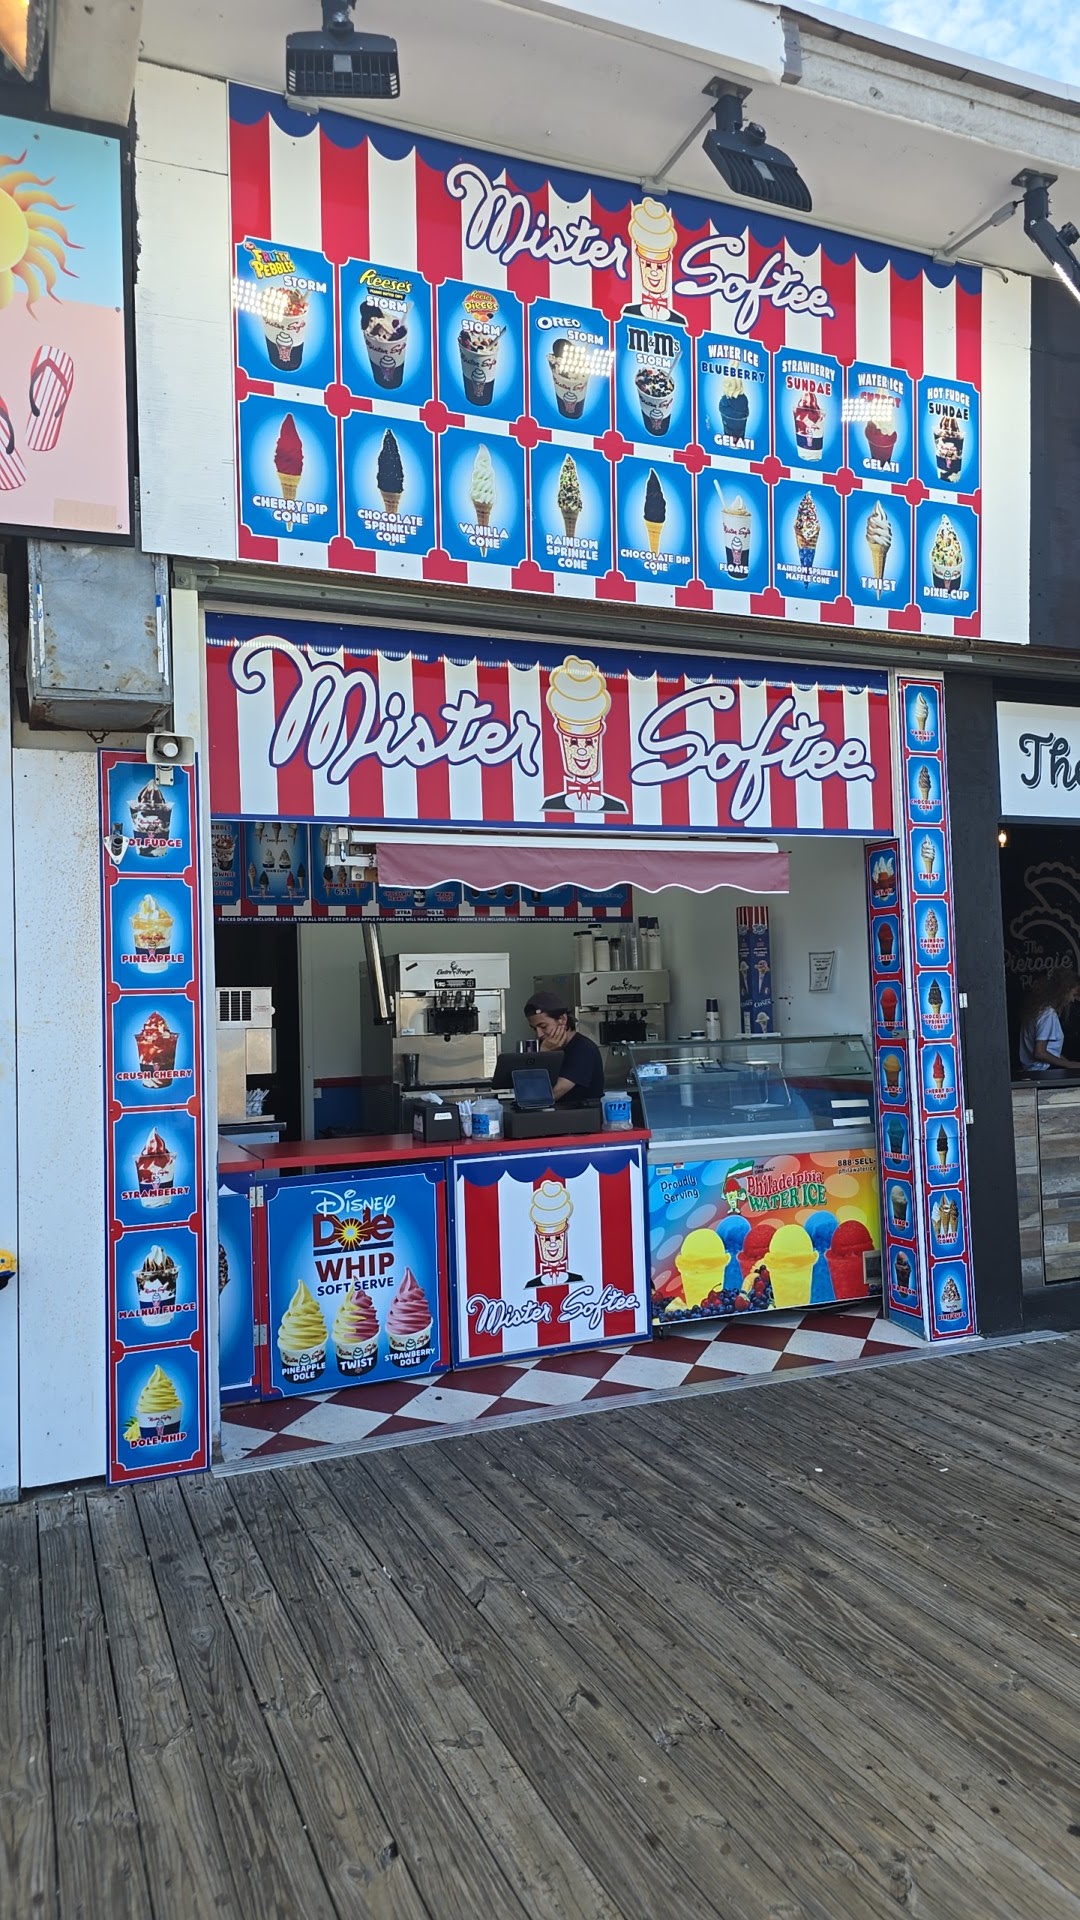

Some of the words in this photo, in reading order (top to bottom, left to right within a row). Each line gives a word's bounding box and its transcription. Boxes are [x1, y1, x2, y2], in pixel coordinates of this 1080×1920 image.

[253, 249, 291, 262] FRUITY
[446, 162, 628, 279] Mister
[674, 235, 834, 334] Softee
[251, 259, 295, 279] PEBBLES
[283, 276, 326, 293] STORM
[360, 268, 413, 294] Reese's
[366, 295, 407, 313] STORM
[461, 319, 501, 336] STORM
[536, 316, 581, 330] OREO
[567, 330, 604, 345] STORM
[637, 353, 672, 369] STORM
[708, 344, 741, 362] WATER
[743, 348, 759, 368] ICE
[701, 362, 766, 384] BLUEBERRY
[781, 359, 836, 382] STRAWBERRY
[786, 376, 832, 396] SUNDAE
[858, 372, 888, 391] WATER
[889, 374, 904, 395] ICE
[927, 387, 944, 402] HOT
[945, 389, 970, 407] FUDGE
[928, 402, 969, 421] SUNDAE
[714, 434, 755, 451] GELATI
[862, 457, 900, 474] GELATI
[252, 495, 304, 512] CHERRY
[306, 501, 328, 516] DIP
[273, 509, 309, 525] CONE
[357, 509, 423, 527] CHOCOLATE
[364, 519, 417, 536] SPRINKLE
[459, 522, 509, 539] VANILLA
[375, 530, 406, 544] CONE
[468, 535, 501, 549] CONE
[545, 534, 599, 550] RAINBOW
[546, 545, 599, 561] SPRINKLE
[620, 548, 674, 564] CHOCOLATE
[675, 555, 691, 565] DIP
[557, 557, 588, 571] CONE
[643, 560, 669, 572] CONE
[719, 562, 749, 574] FLOATS
[776, 562, 808, 575] RAINBOW
[808, 565, 839, 578] SPRINKLE
[785, 572, 812, 583] WAFFLE
[812, 575, 830, 585] CONE
[861, 577, 897, 592] TWIST
[923, 586, 950, 599] DIXIE
[950, 589, 970, 601] CUP
[228, 635, 540, 785] Mister
[630, 684, 876, 821] Softee
[128, 838, 141, 847] OT
[143, 838, 182, 848] FUDGE
[918, 873, 939, 881] TWIST
[121, 954, 184, 964] PINEAPPLE
[116, 1071, 152, 1080] CRUSH
[153, 1069, 193, 1079] CHERRY
[660, 1175, 697, 1192] Proudly
[746, 1170, 822, 1196] Philadelphia
[121, 1186, 190, 1200] STRAWBERRY
[663, 1189, 699, 1204] Serving
[748, 1187, 799, 1211] WATER
[801, 1183, 827, 1207] ICE
[313, 1208, 395, 1250] Dole
[315, 1252, 395, 1283] WHIP
[317, 1282, 352, 1296] SOFT
[354, 1277, 395, 1292] SERVE
[118, 1306, 161, 1319] WALNUT
[163, 1303, 196, 1313] FUDGE
[466, 1292, 553, 1335] Mister
[558, 1284, 640, 1330] Softee
[384, 1347, 436, 1362] STRAWBERRY
[399, 1356, 421, 1366] DOLE
[282, 1362, 326, 1375] PINEAPPLE
[339, 1357, 374, 1371] TWIST
[293, 1371, 315, 1381] DOLE
[130, 1438, 159, 1449] DOLE
[161, 1432, 187, 1443] WHIP
